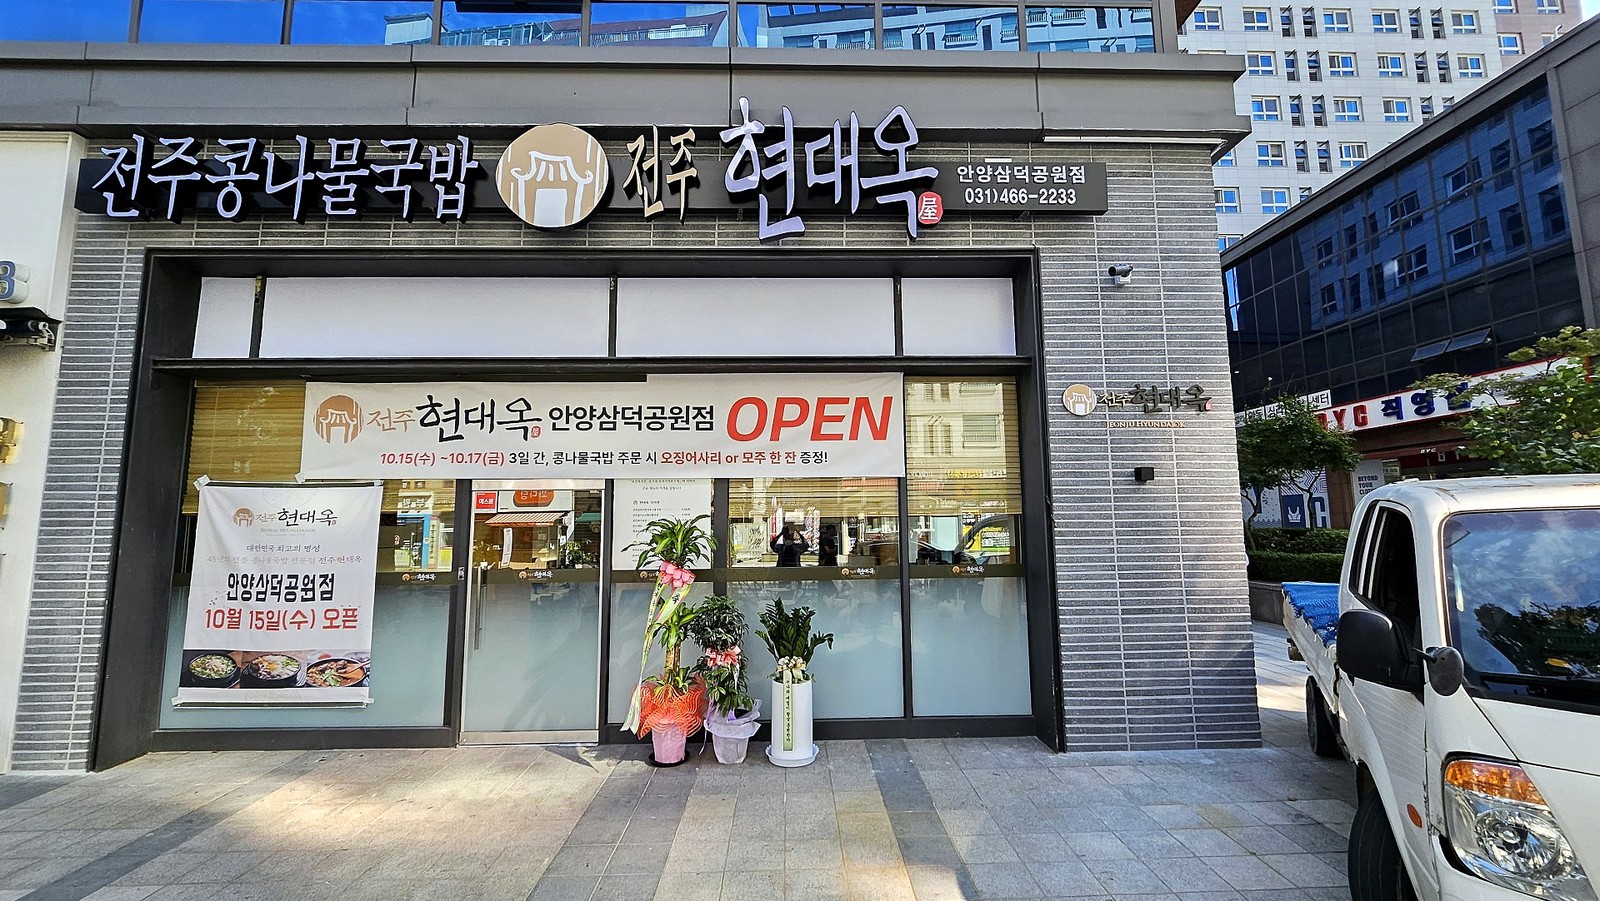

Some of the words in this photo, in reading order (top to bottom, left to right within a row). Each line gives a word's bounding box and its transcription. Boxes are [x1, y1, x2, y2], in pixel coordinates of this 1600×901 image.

[92, 134, 478, 220] 전주콩나물국밥
[622, 124, 698, 219] 전주
[719, 97, 938, 241] 현대옥
[957, 165, 1085, 184] 안양삼덕공원점
[965, 188, 1076, 204] 031)466-2233
[1099, 391, 1131, 408] 전주
[1128, 384, 1212, 413] 현대옥
[367, 408, 416, 433] 전주
[415, 395, 542, 443] 현대옥
[549, 405, 714, 431] 안양삼덕공원점
[726, 396, 893, 442] OPEN
[380, 452, 435, 466] 10.15(수)
[440, 452, 505, 466] ~10.17(금)
[508, 452, 529, 465] 3일
[533, 452, 549, 466] 간,
[552, 451, 614, 465] 콩나물국밥
[617, 451, 642, 465] 주문
[645, 451, 657, 465] 시
[660, 451, 722, 465] 오징어사리
[725, 454, 739, 464] or
[742, 451, 766, 465] 모주
[769, 451, 781, 465] 한
[784, 451, 796, 465] 잔
[799, 451, 828, 465] 증정!
[256, 513, 277, 523] 전주
[277, 508, 338, 526] 현대옥
[246, 544, 274, 552] 대한민국
[277, 544, 301, 553] 최고의
[303, 544, 321, 553] 명성
[227, 573, 335, 602] 안양삼덕공원점
[205, 608, 242, 630] 10월
[249, 608, 316, 631] 15일(수)
[322, 608, 358, 630] 오픈
